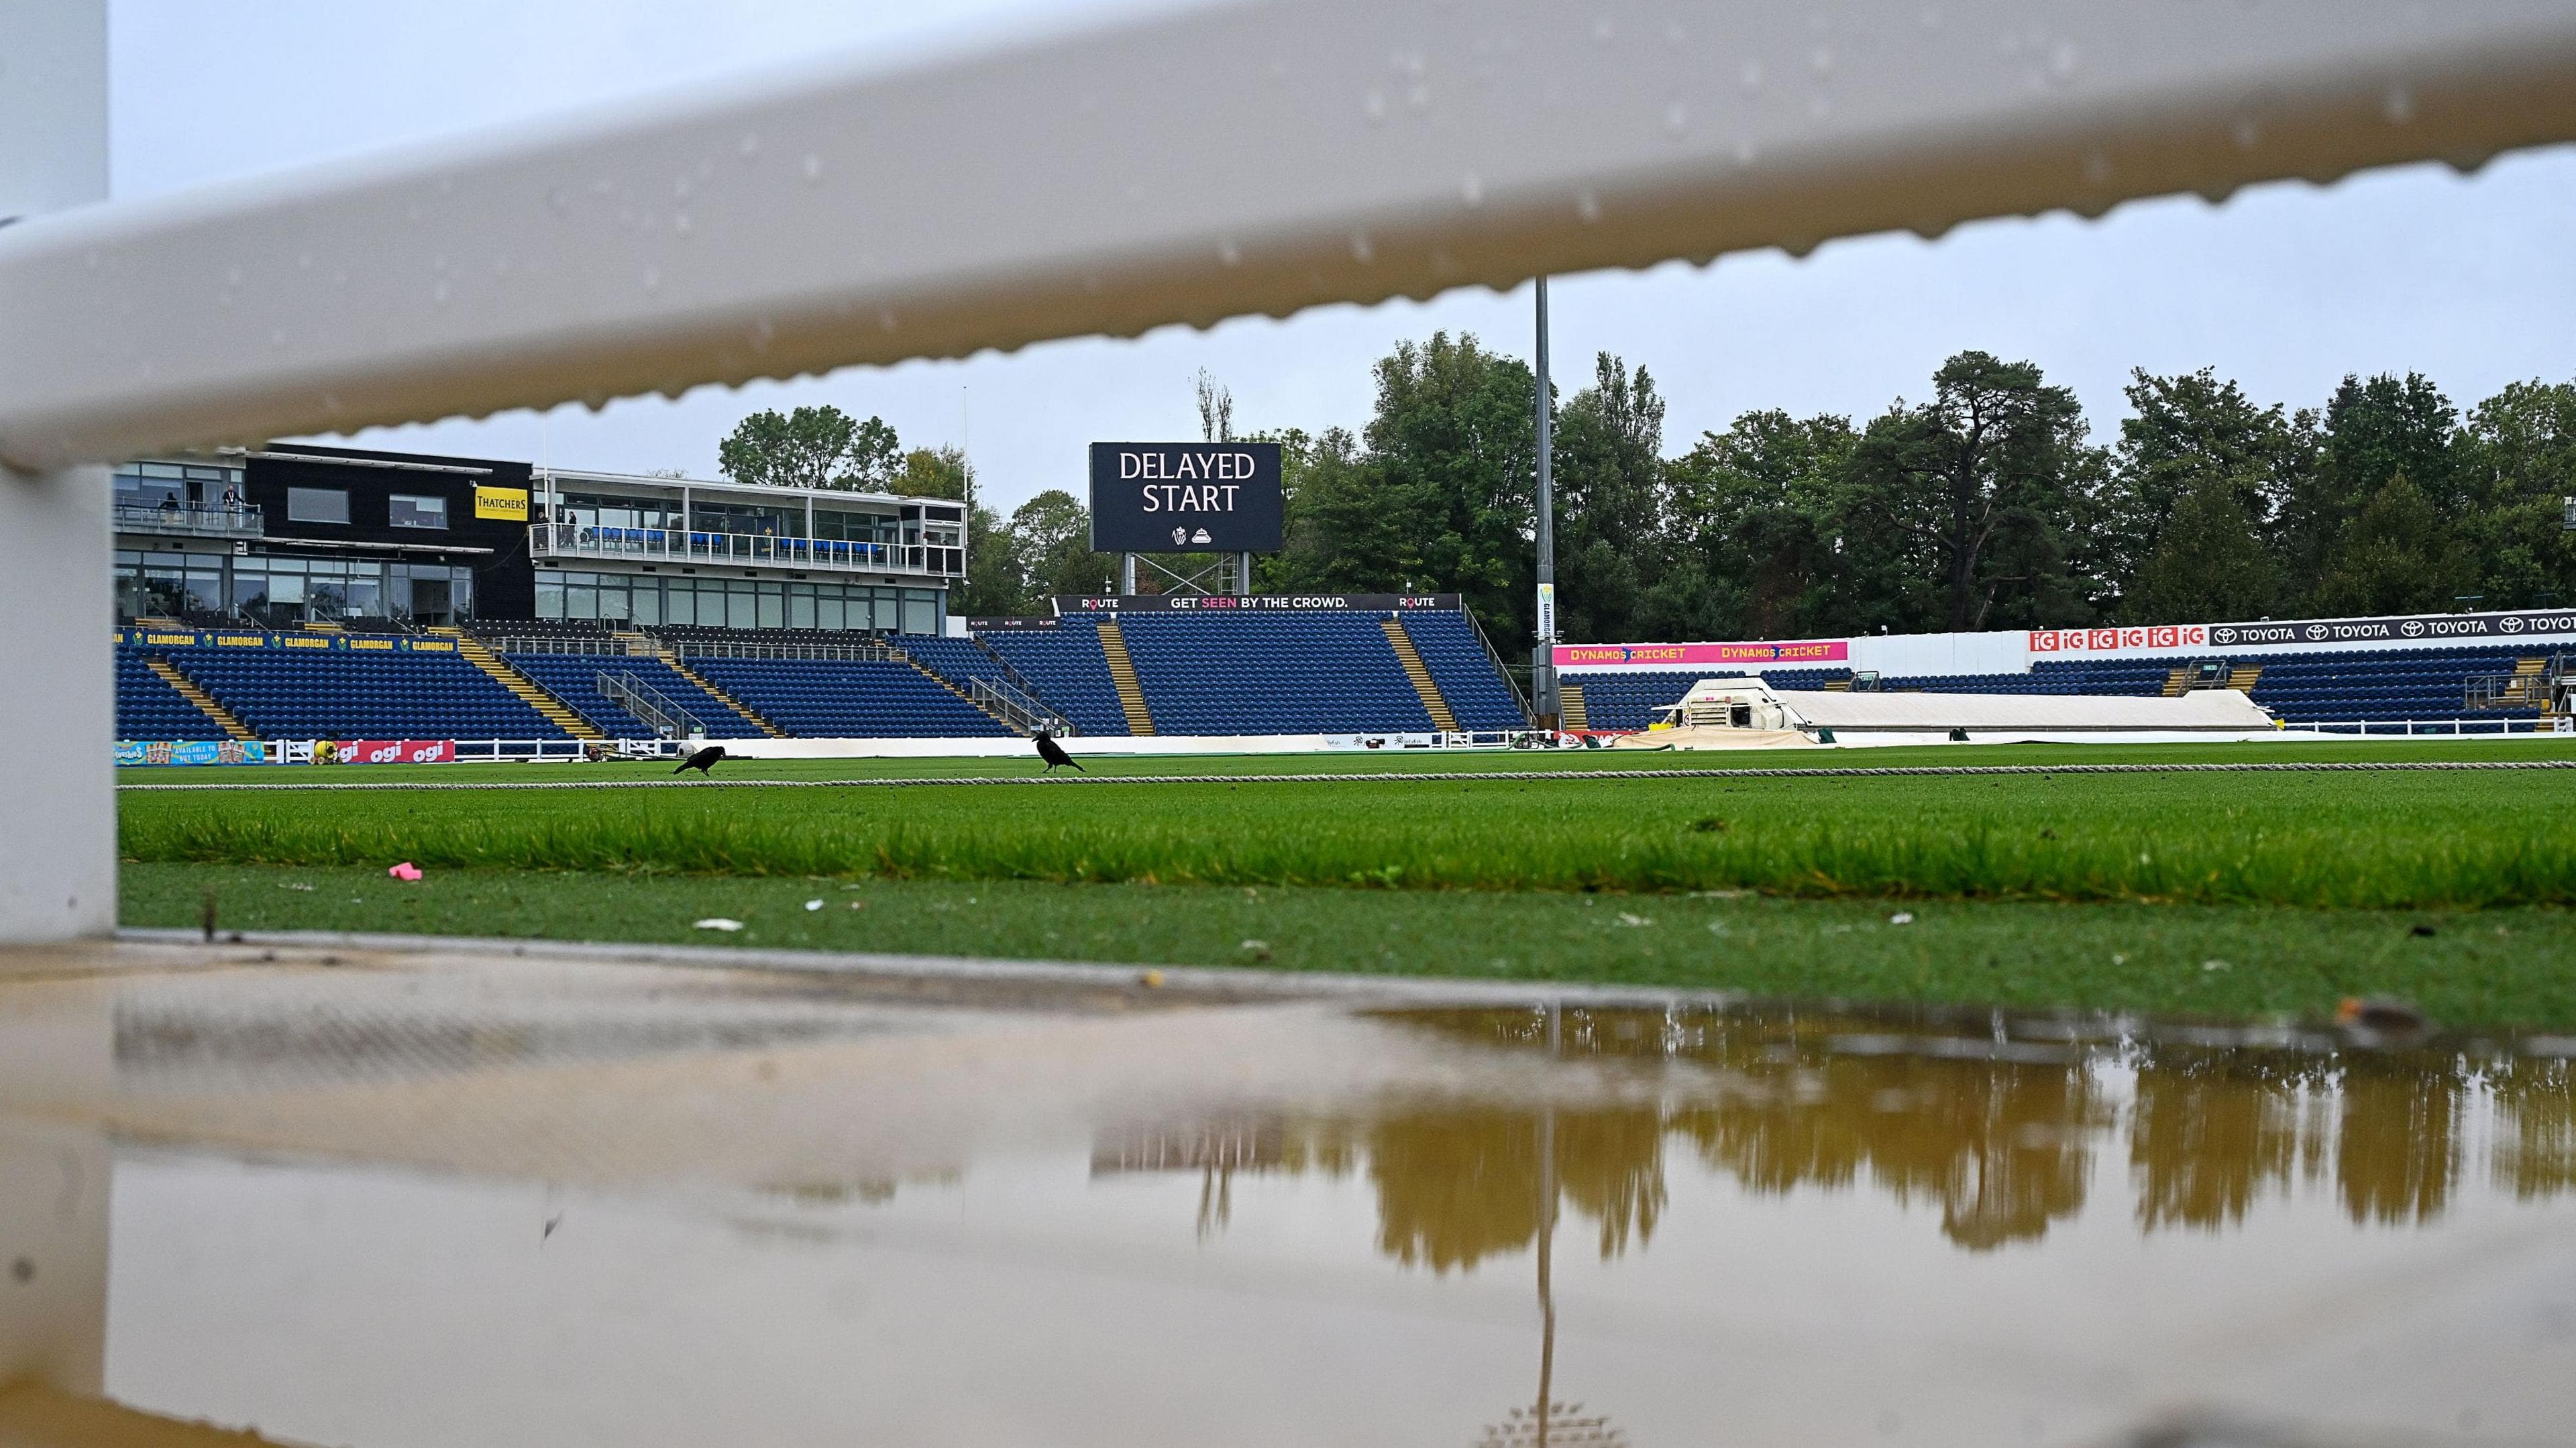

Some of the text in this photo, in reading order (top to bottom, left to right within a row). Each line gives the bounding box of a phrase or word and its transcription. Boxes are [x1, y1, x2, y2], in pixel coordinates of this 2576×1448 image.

[1120, 453, 1255, 479] DELAYED
[477, 496, 526, 510] THATCHERS
[1142, 484, 1240, 512] START
[1081, 599, 1118, 610] ROUTE
[1171, 598, 1348, 608] GET SEEN BY THE CROWD.
[1399, 598, 1435, 608] ROUTE
[2428, 620, 2487, 634] TOYOTA
[2528, 617, 2576, 630] TOYOT
[2241, 628, 2296, 641] TOYOTA
[2332, 624, 2390, 638] TOYOTA
[148, 634, 195, 645] GLAMORGAN
[217, 636, 264, 646] GLAMORGAN
[284, 638, 329, 648] GLAMORGAN
[350, 639, 393, 649] GLAMORGAN
[412, 641, 453, 651] GLAMORGAN
[1570, 648, 1686, 661] DYNAMOS CRICKET
[1721, 645, 1831, 658] DYNAMOS CRICKET
[175, 746, 205, 755] AVAILABLE
[193, 753, 211, 761] TODAY
[338, 740, 358, 763] gi
[370, 740, 402, 763] ogi
[413, 740, 443, 762] ogi
